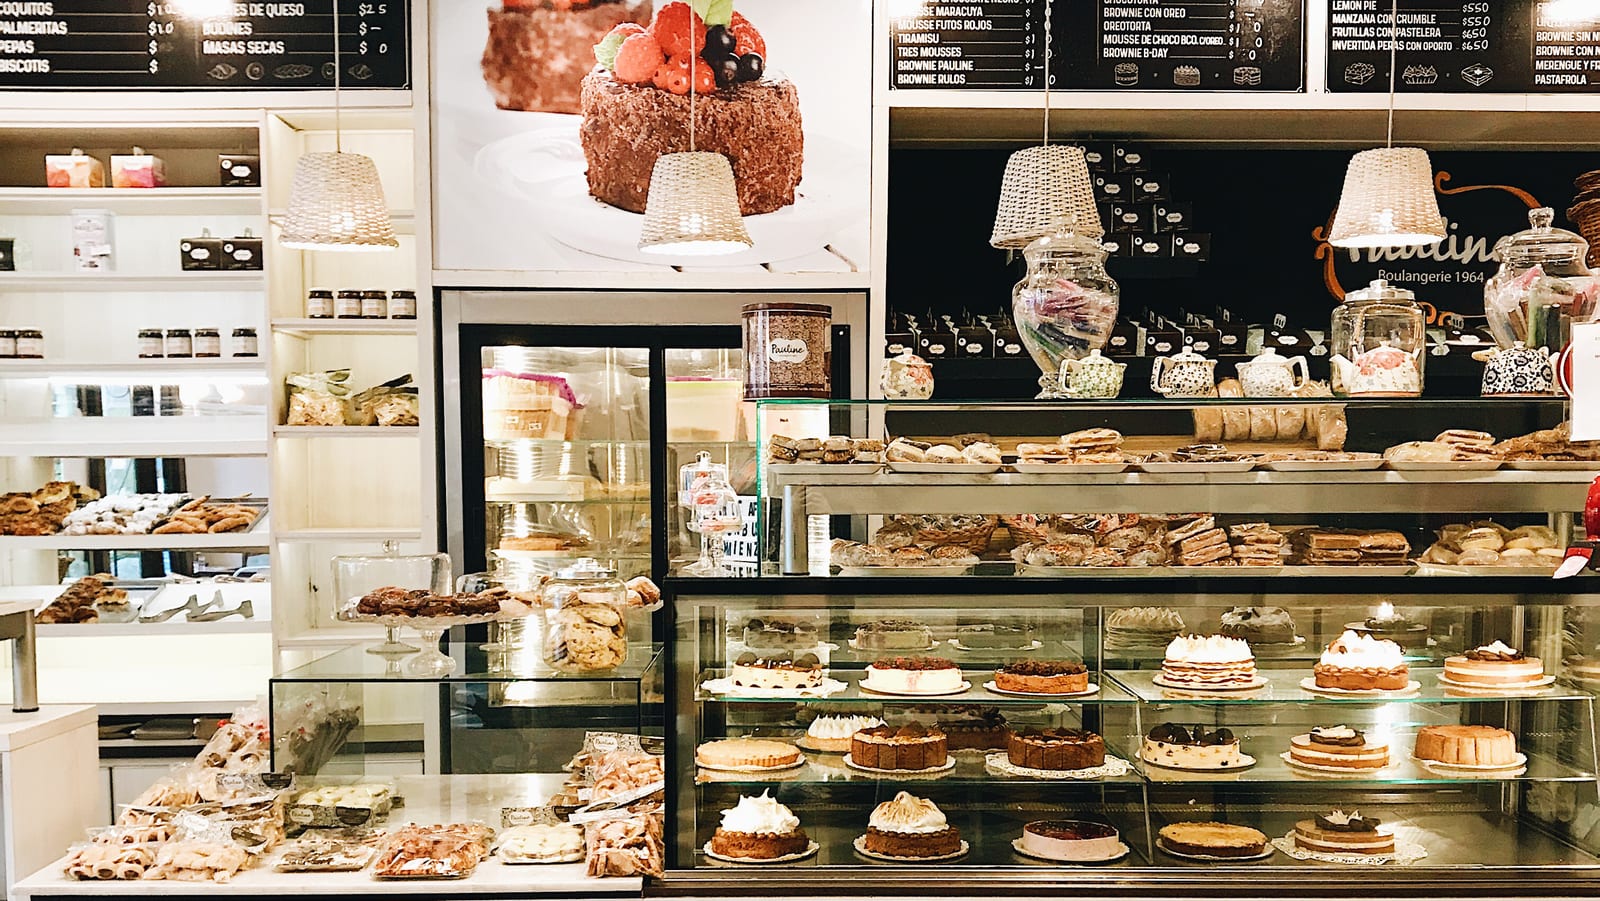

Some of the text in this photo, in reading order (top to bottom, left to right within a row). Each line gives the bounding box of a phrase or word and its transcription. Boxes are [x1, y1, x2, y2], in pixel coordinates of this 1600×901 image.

[249, 3, 264, 16] DE
[266, 3, 304, 18] QUESO
[936, 6, 983, 17] MARACUYA
[1332, 0, 1489, 13] LEMON PIE $550
[1103, 7, 1142, 18] BROWNIE
[1143, 7, 1162, 18] CON
[1163, 8, 1186, 18] OREO
[897, 19, 934, 30] MOUSSE
[964, 19, 992, 31] ROJOS
[1332, 13, 1491, 27] MANZANA CON CRUMBLE $550
[1103, 21, 1152, 31] OREOTORTA
[898, 33, 940, 44] TIRAMISU
[1332, 27, 1487, 39] FRUTILLAS CON PASTELERA $650
[1536, 31, 1575, 42] BROWNIE
[1576, 31, 1591, 42] SIN
[1103, 34, 1140, 45] MOUSSE
[1141, 34, 1152, 45] DE
[1152, 34, 1180, 45] CHOCO
[1332, 39, 1489, 51] INVERTIDA PERAS CON OPORTO $650
[203, 41, 246, 54] MASAS
[247, 41, 284, 54] SECAS
[898, 47, 919, 57] TRES
[920, 47, 962, 57] MOUSSES
[1103, 48, 1142, 58] BROWNIE
[1143, 48, 1169, 58] B-DAY
[1536, 45, 1575, 56] BROWNIE
[1575, 45, 1594, 56] CON
[0, 59, 50, 73] BISCOTIS
[898, 60, 937, 71] BROWNIE
[938, 60, 974, 71] PAULINE
[1535, 60, 1582, 70] MERENGUE
[1583, 60, 1589, 70] Y
[898, 74, 937, 84] BROWNIE
[938, 74, 966, 84] RULOS
[1535, 74, 1587, 85] PASTAFROLA
[1378, 269, 1484, 285] Boulangerie 1964
[771, 343, 805, 354] Pauline
